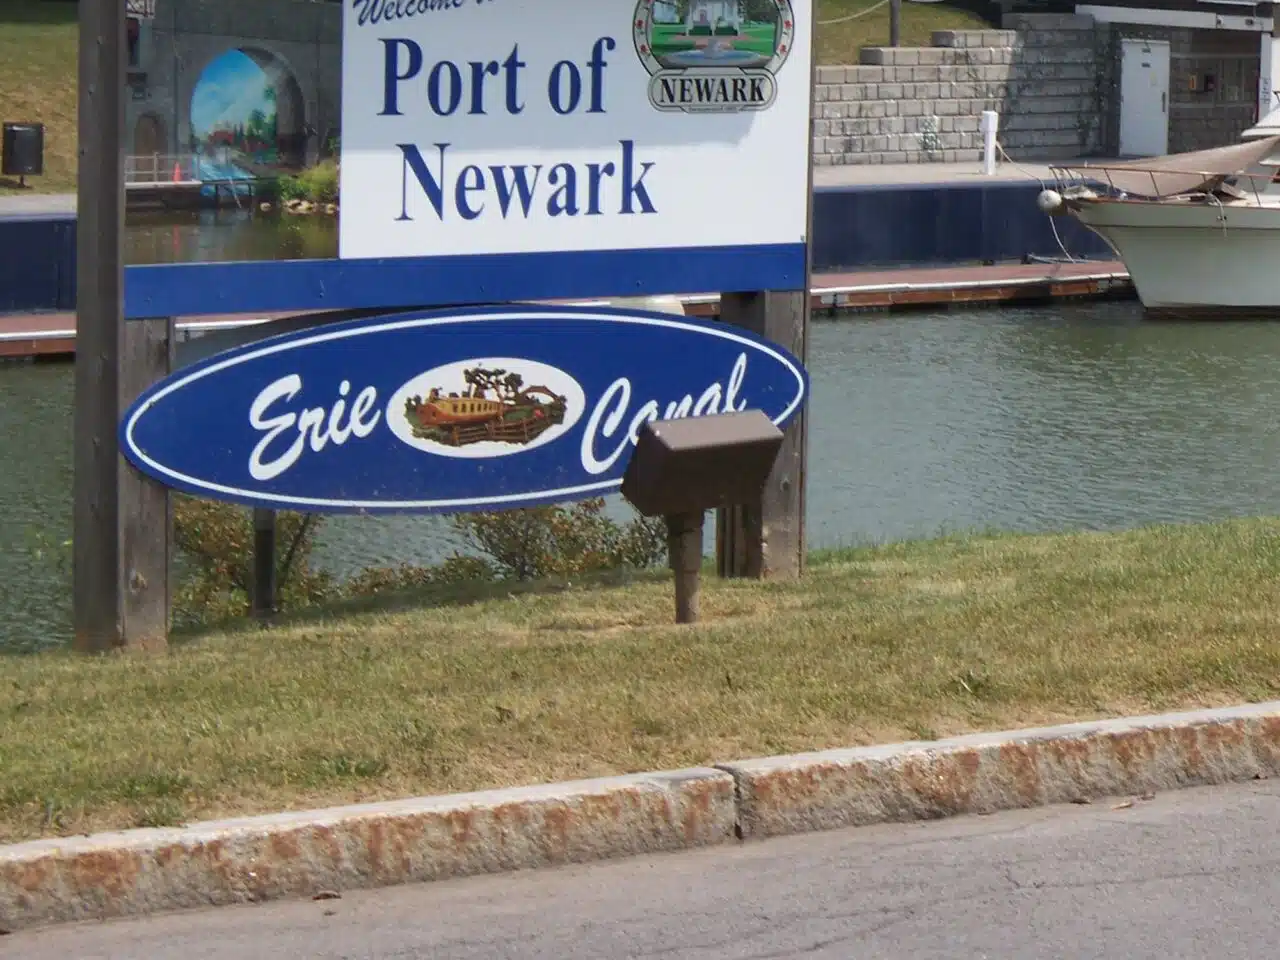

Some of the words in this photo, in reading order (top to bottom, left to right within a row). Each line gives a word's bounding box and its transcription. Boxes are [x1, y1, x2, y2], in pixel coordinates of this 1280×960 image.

[376, 38, 526, 116] Port
[547, 36, 616, 115] of
[659, 77, 766, 103] NEWARK
[393, 139, 659, 222] Newark
[249, 374, 381, 480] Erie
